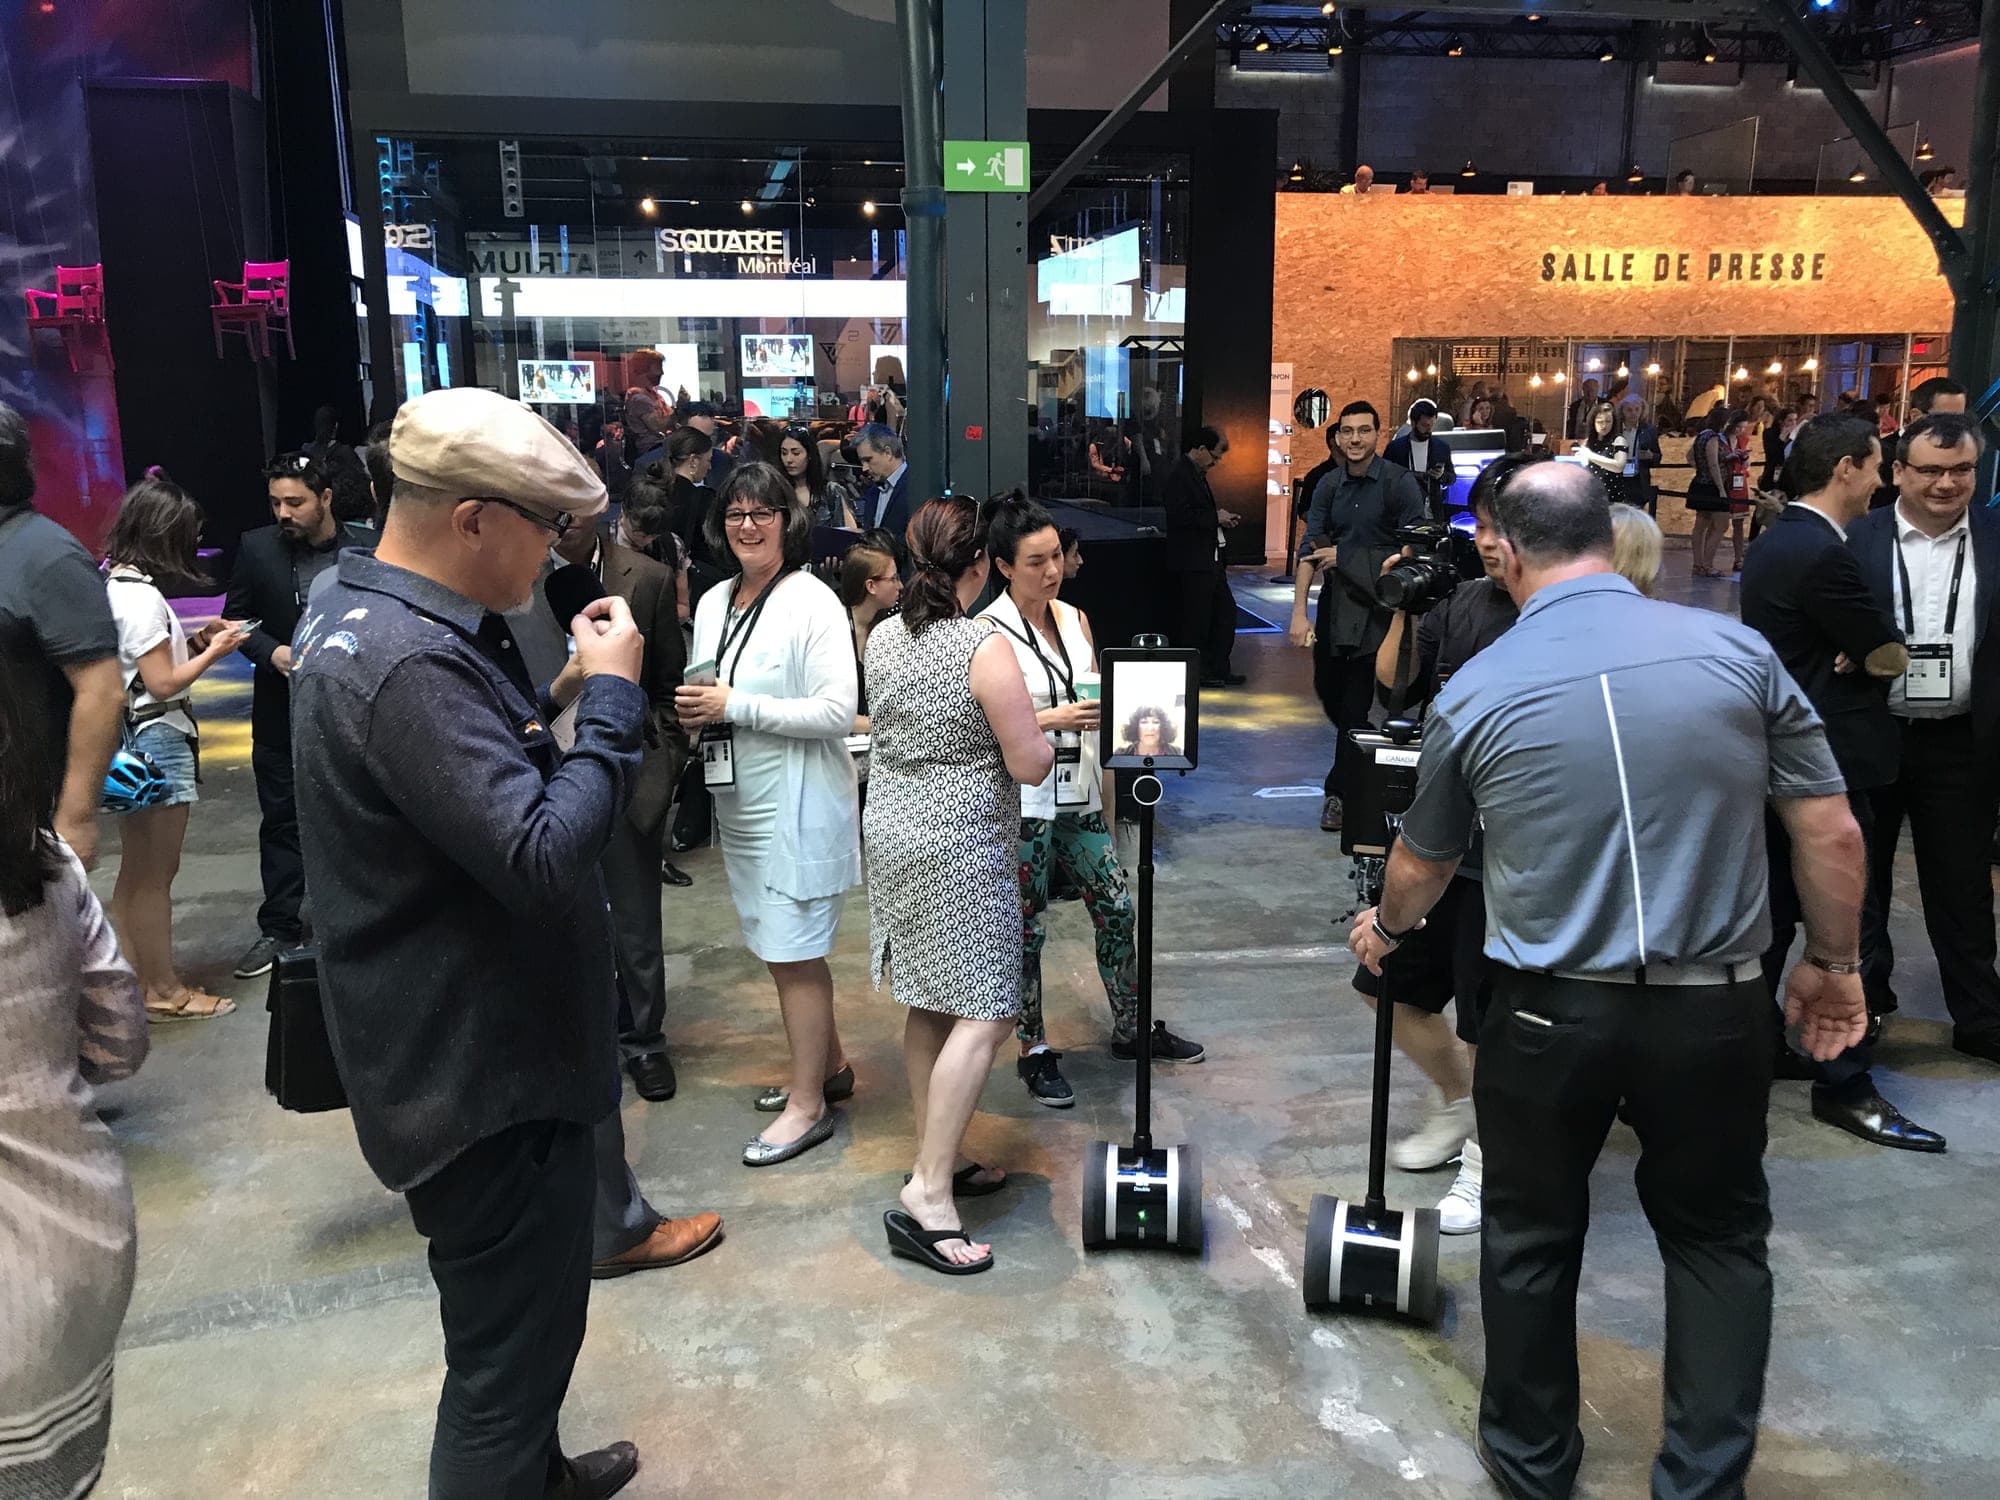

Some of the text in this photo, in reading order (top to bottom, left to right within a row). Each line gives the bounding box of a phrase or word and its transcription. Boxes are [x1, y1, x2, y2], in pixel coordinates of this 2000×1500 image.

[659, 228, 784, 254] SQUARE
[738, 256, 817, 275] Montréal
[1541, 253, 1825, 282] SALLE DE PRESSE
[1520, 347, 1565, 358] PESSE
